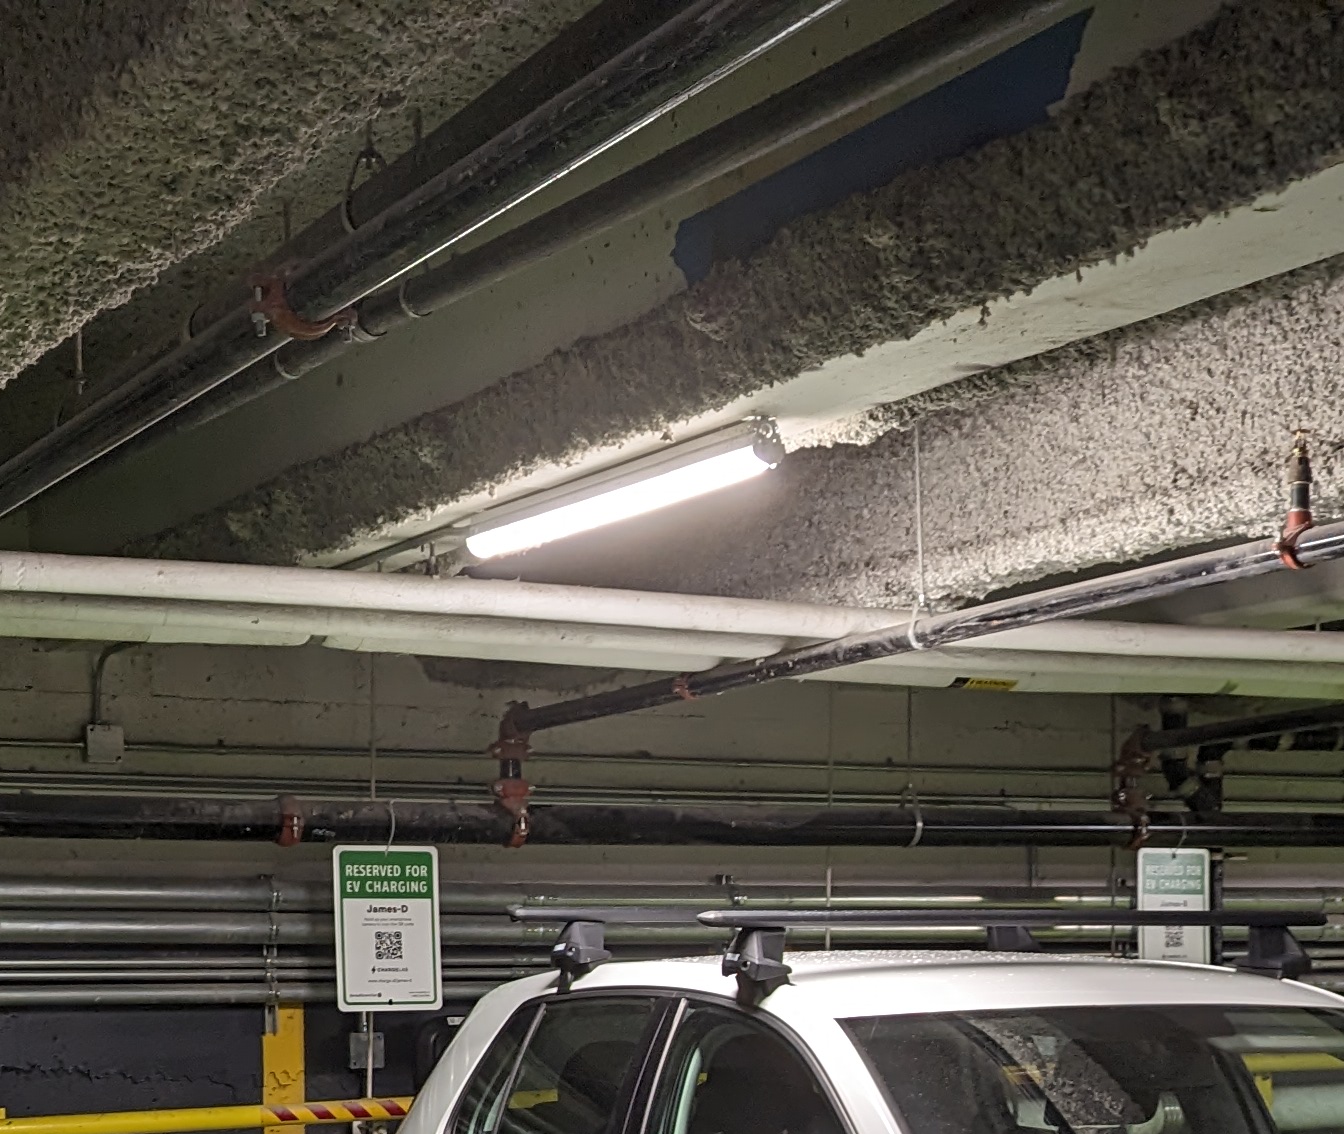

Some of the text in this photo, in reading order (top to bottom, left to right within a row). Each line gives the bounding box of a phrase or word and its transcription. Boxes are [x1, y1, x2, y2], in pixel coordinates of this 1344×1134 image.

[345, 864, 428, 877] RESERVED FOR
[346, 881, 428, 893] EV CHARGING
[1158, 879, 1202, 890] CHARGING
[366, 904, 409, 913] James-D
